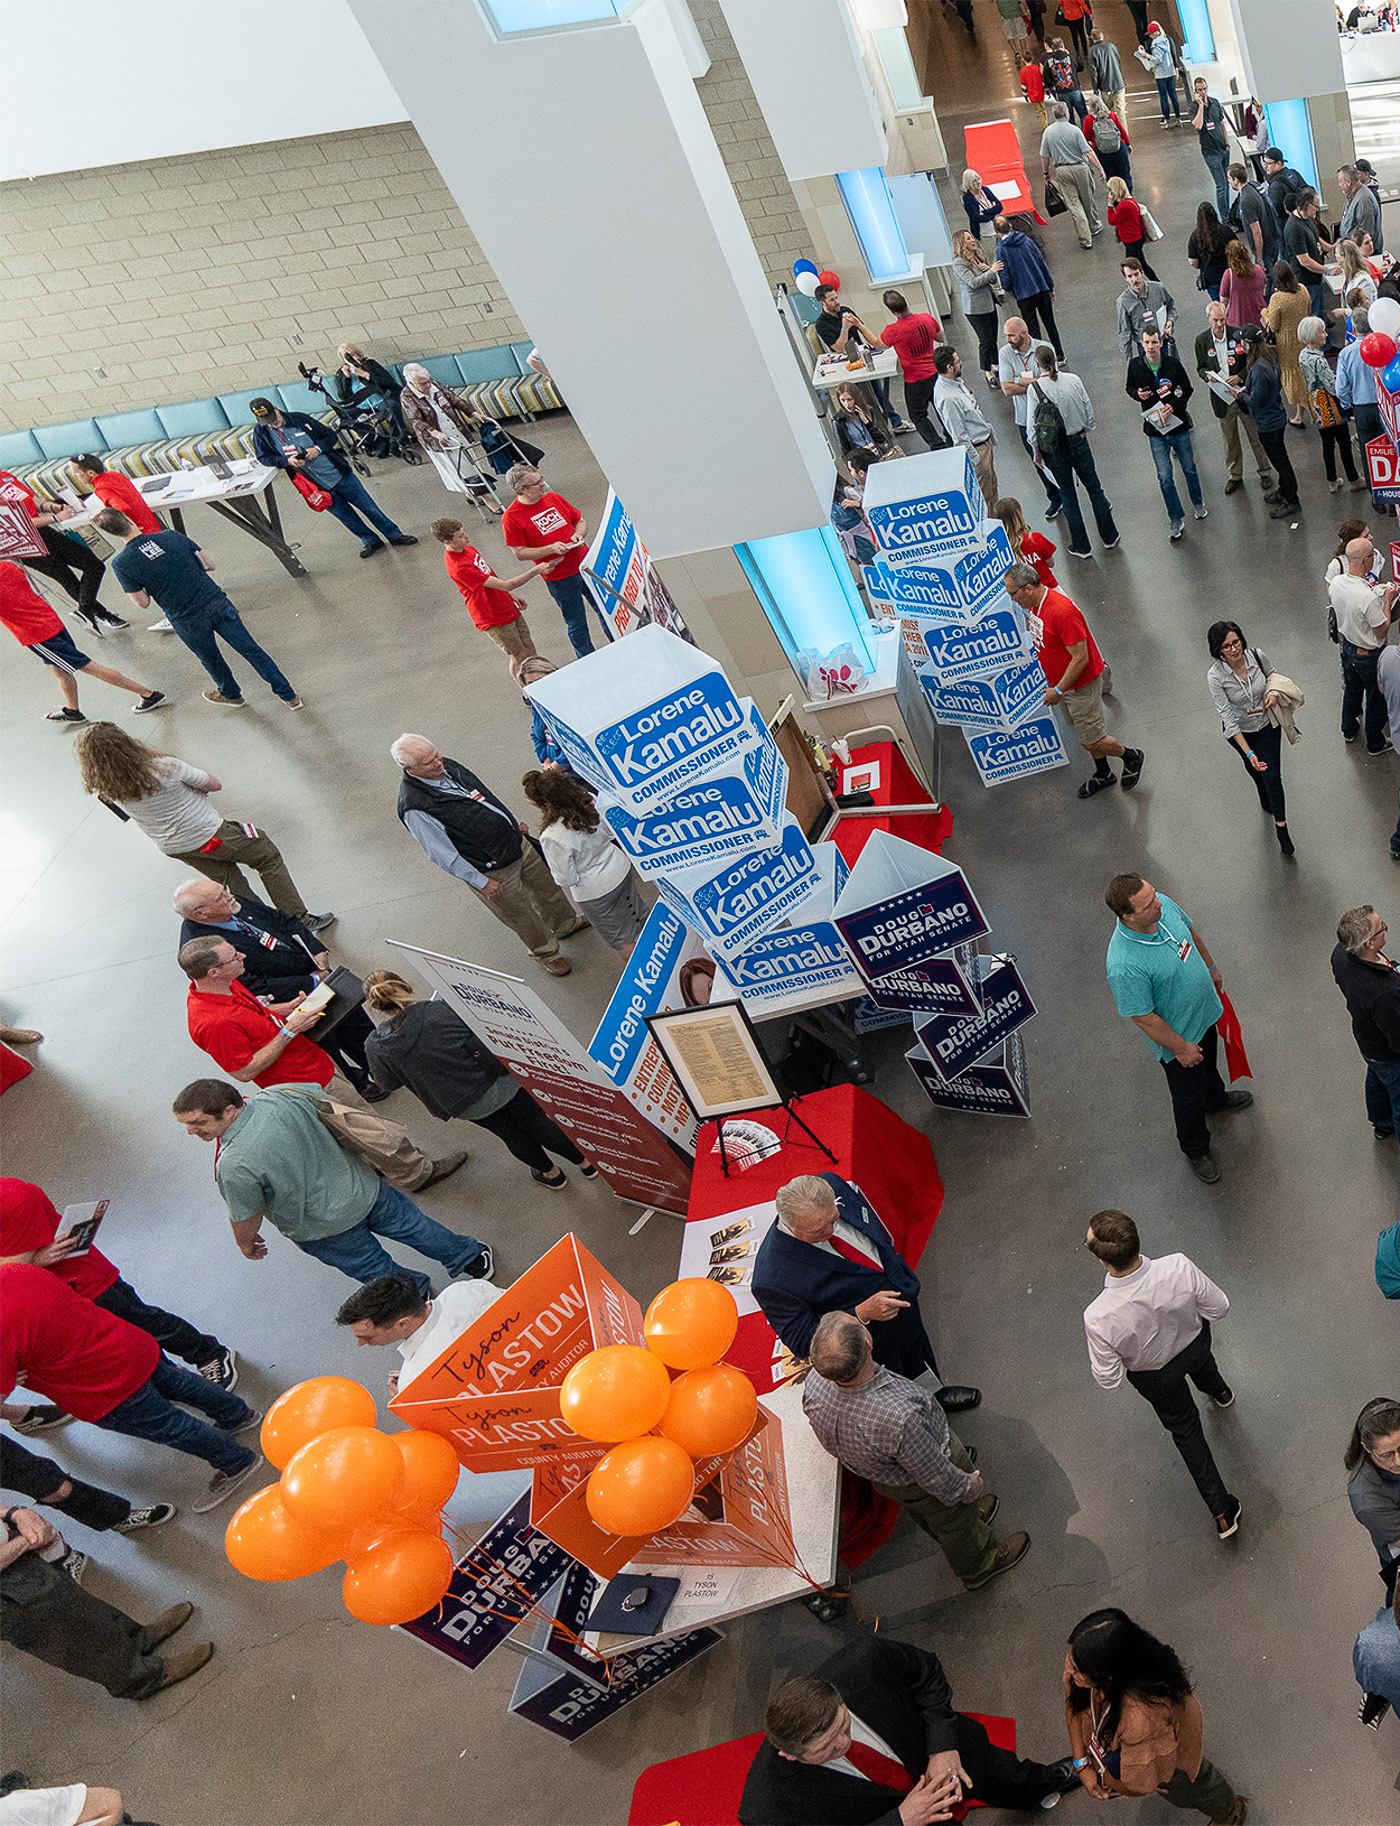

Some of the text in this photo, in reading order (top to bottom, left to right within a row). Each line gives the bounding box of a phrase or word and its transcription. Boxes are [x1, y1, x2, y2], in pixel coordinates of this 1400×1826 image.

[535, 511, 560, 530] KOCH
[886, 499, 948, 520] Lorene
[877, 511, 972, 547] Kamalu
[889, 538, 966, 562] COMMISSIONER
[895, 567, 940, 582] Lorene
[961, 547, 1013, 602] Kamalu
[887, 578, 959, 607] Kamalu
[896, 604, 959, 618] COMMISSIONER
[933, 630, 1019, 665] Kamalu
[941, 619, 998, 641] Lorene
[941, 653, 1013, 678] COMMISSIONER
[619, 690, 705, 743] Lorene
[928, 689, 999, 715] Kamalu
[937, 711, 995, 725] COMMISSIONER
[611, 700, 741, 784] Kamalu
[978, 734, 1059, 769] Kamalu
[985, 725, 1039, 747] Lorene
[632, 737, 737, 804] COMMISSIONER
[656, 750, 741, 802] www.LoreneKamalu.com
[986, 754, 1054, 781] COMMISSIONER
[621, 801, 758, 853] Kamalu
[640, 833, 753, 871] COMMISSIONER
[713, 844, 783, 896] Lorene
[705, 849, 811, 933] Kamalu
[723, 881, 808, 950] COMMISSIONER
[857, 902, 969, 956] DURBANO
[873, 910, 918, 935] DOUG
[868, 916, 973, 963] FOR UTAH SENATE
[730, 940, 847, 987] Kamalu
[597, 994, 646, 1077] Lorene
[636, 912, 680, 992] Kamalu
[741, 967, 843, 1000] COMMISSIONER
[871, 977, 961, 996] DURBANO
[876, 989, 965, 1002] FOR UTAH SENATE
[451, 984, 532, 1019] DURBANO
[935, 989, 1020, 1064] DURBANO
[945, 1001, 1024, 1065] FOR UTAH SENATE
[487, 1034, 588, 1072] Put Freedom
[526, 1055, 571, 1075] First!
[925, 1076, 1011, 1100] DURBANO
[432, 1312, 520, 1382] Tyson
[550, 1339, 589, 1380] AUDITOR
[433, 1405, 531, 1430] Tyson
[451, 1417, 578, 1447] PLASTO
[517, 1449, 606, 1465] COUNTY AUDITOR
[441, 1537, 551, 1642] DURBA
[459, 1543, 520, 1606] DOUG
[684, 1590, 719, 1598] PLASTOW
[463, 1614, 494, 1645] FOR
[645, 1634, 699, 1671] SENATE
